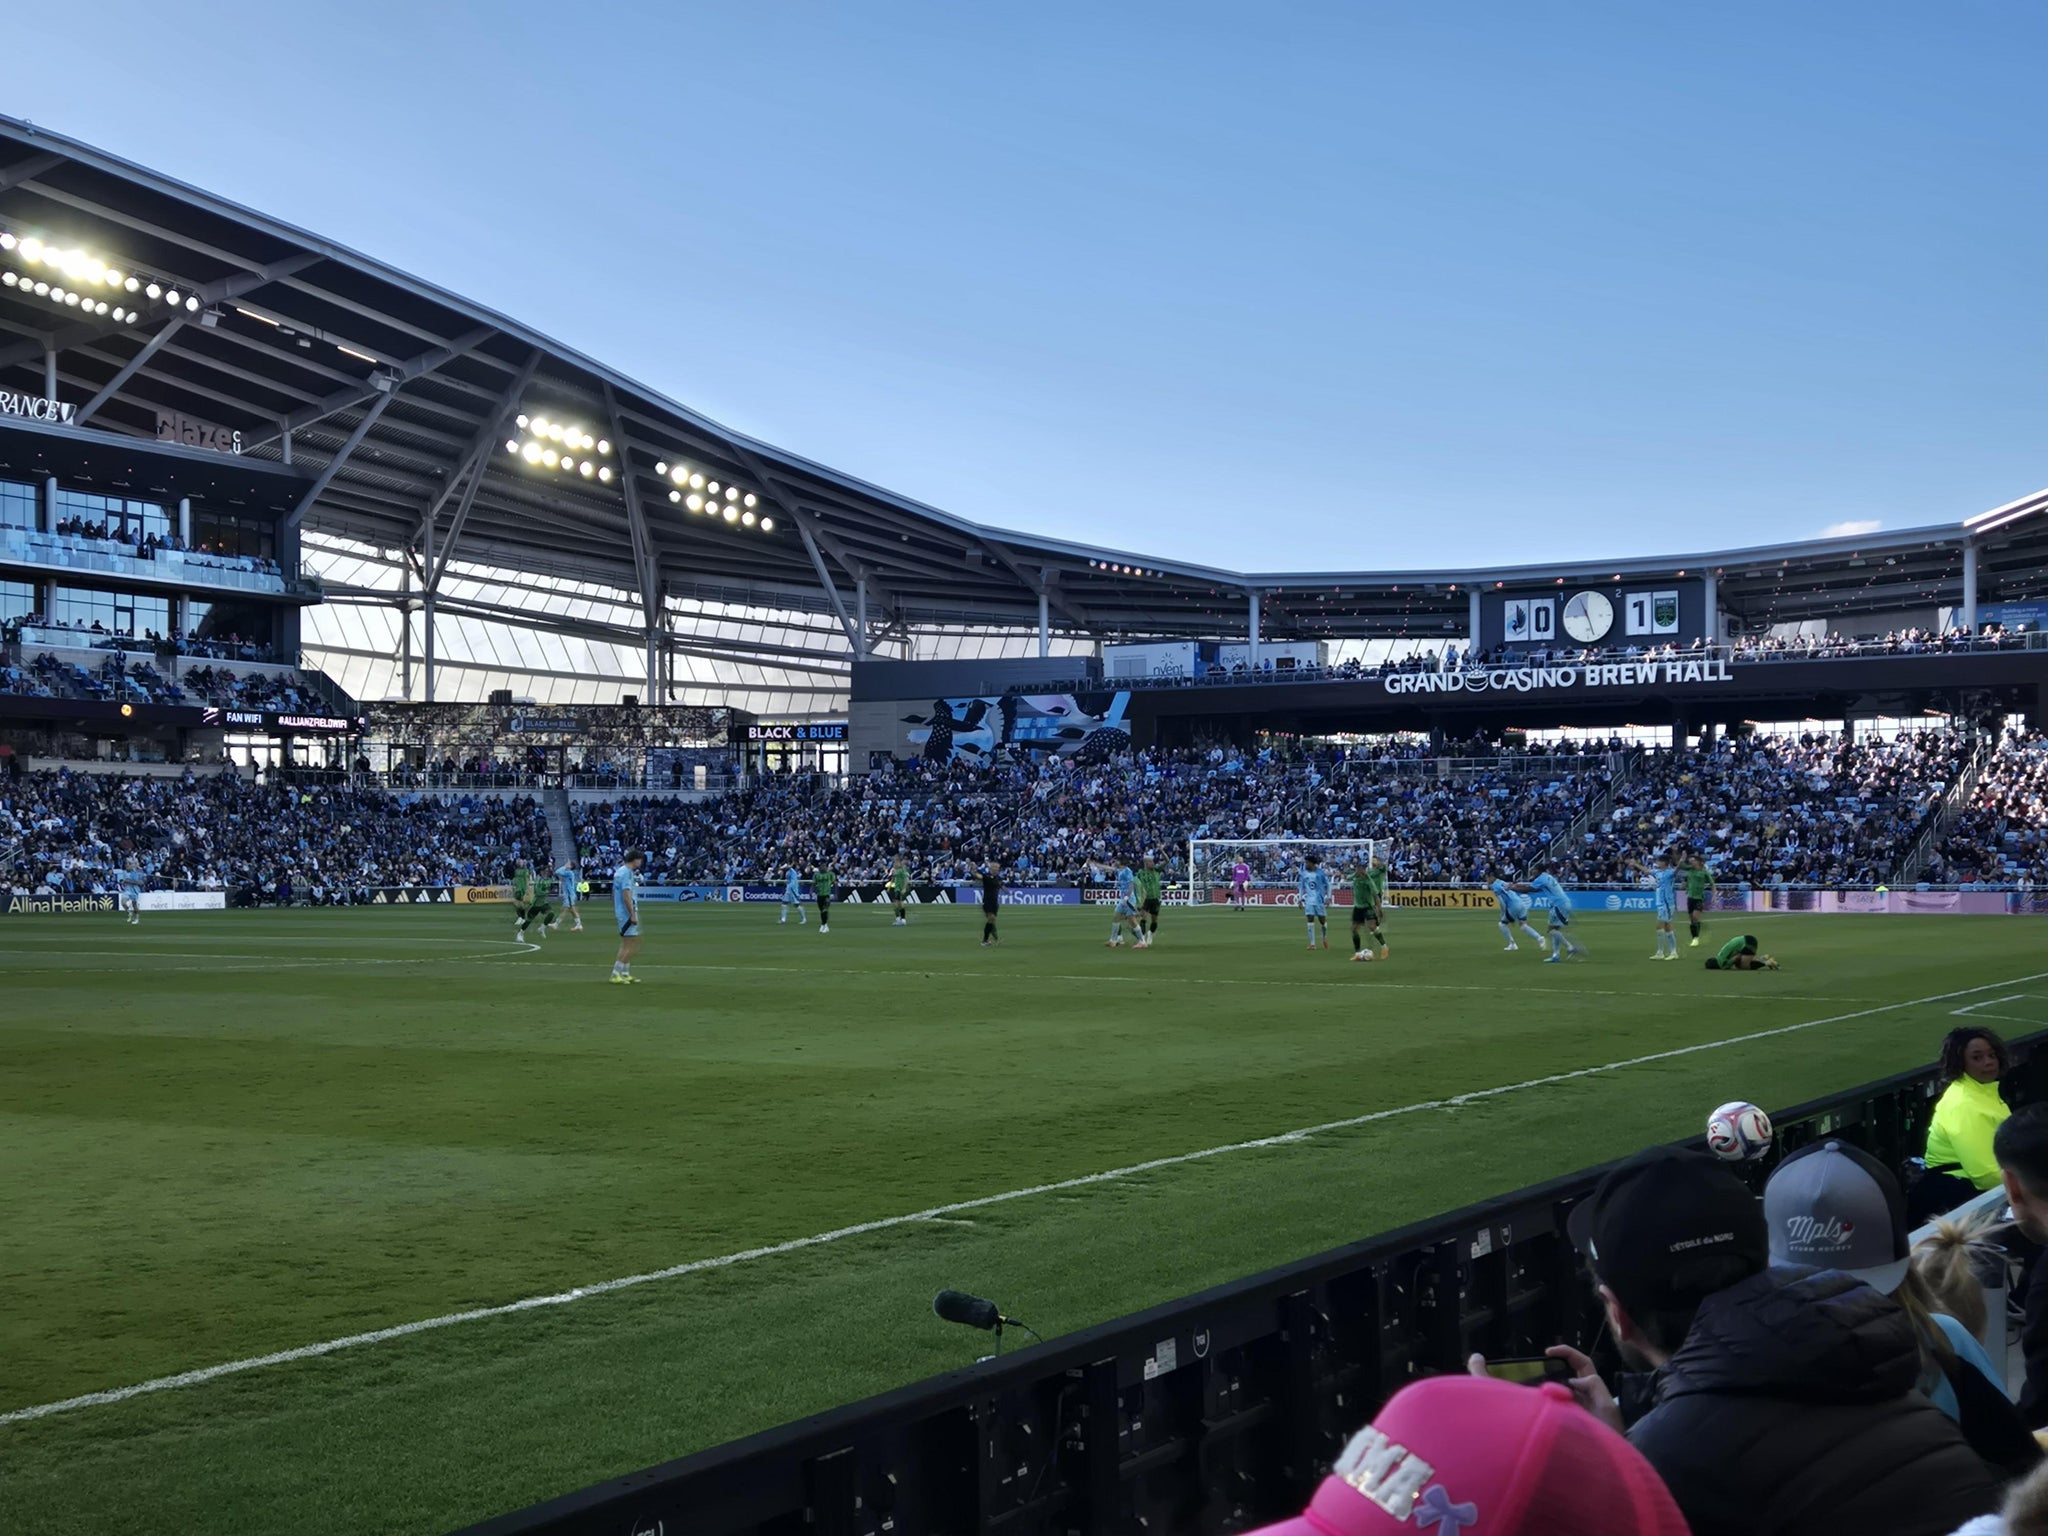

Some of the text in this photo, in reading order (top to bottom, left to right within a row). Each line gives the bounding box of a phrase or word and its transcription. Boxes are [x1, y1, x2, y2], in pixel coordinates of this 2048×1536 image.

[1535, 606, 1550, 633] 0
[1633, 600, 1645, 627] 1
[1384, 659, 1733, 694] GRAND CASINO BREW HALL
[226, 712, 262, 724] FAN WIFI
[748, 727, 842, 739] BLACK & BLUE
[8, 895, 99, 913] Allina Health
[973, 889, 1062, 905] NriSource
[1391, 893, 1495, 907] tinental Tire
[1623, 897, 1654, 908] AT&T
[1787, 1216, 1841, 1244] Mpls
